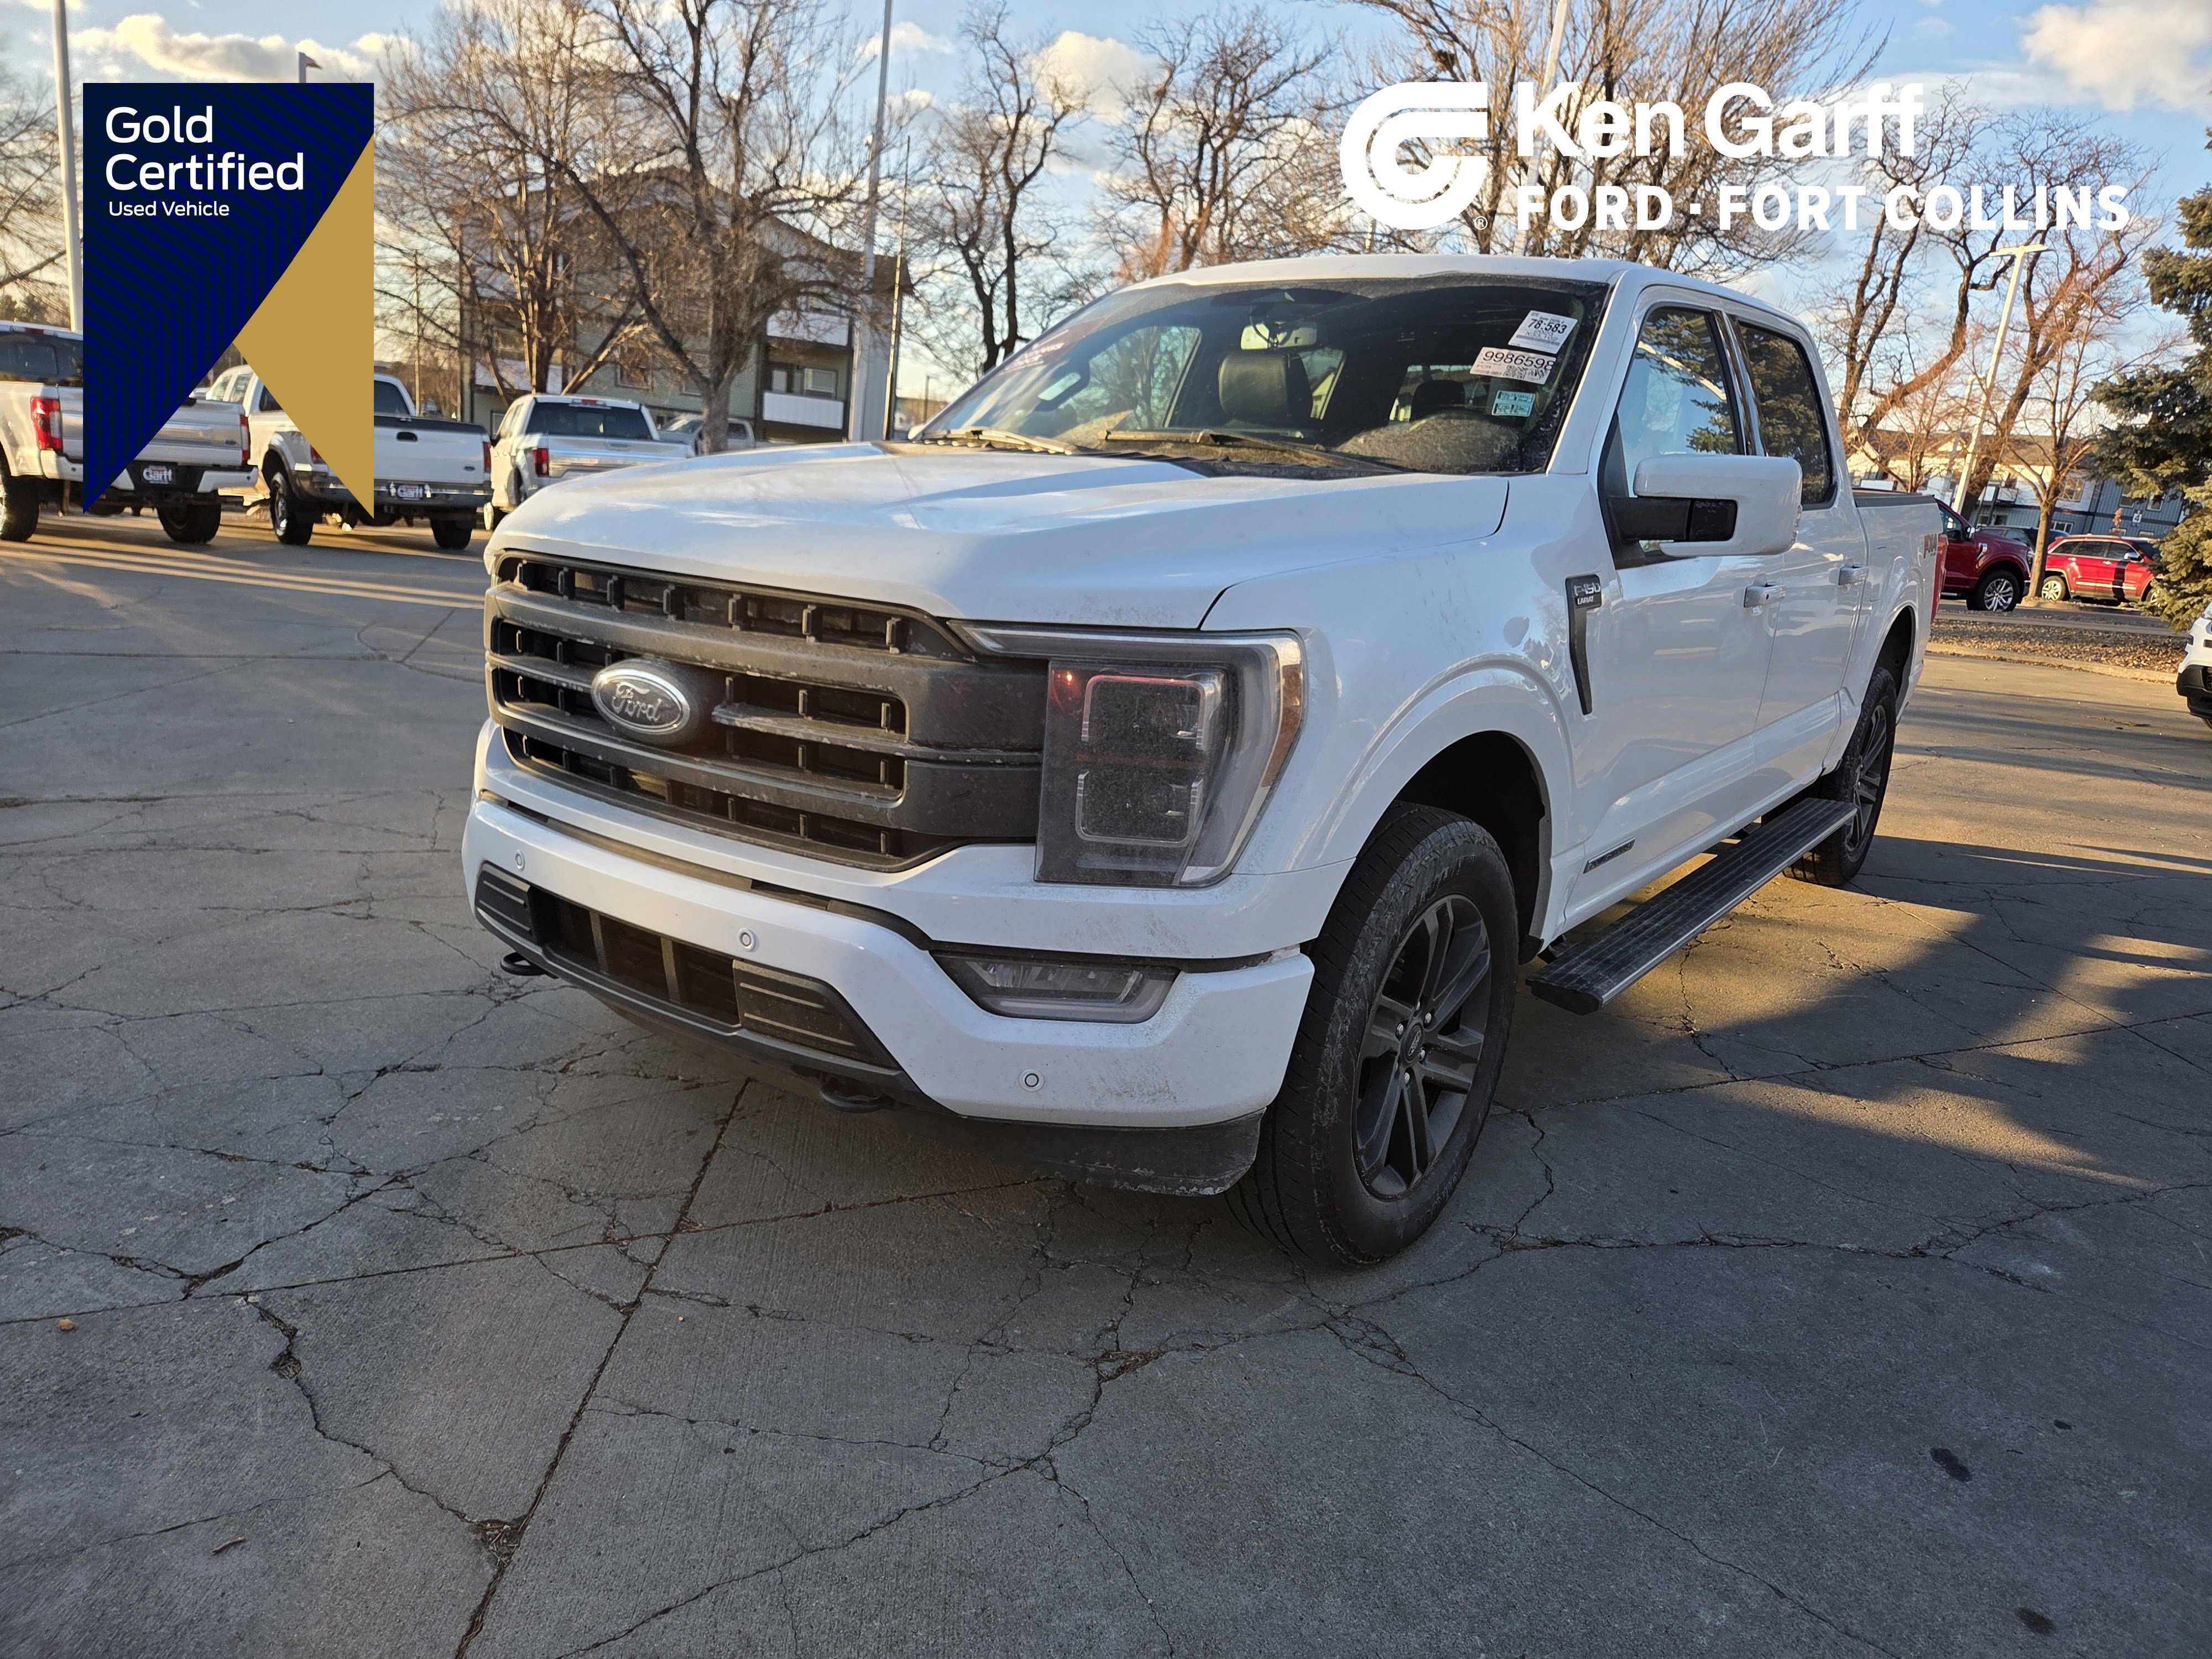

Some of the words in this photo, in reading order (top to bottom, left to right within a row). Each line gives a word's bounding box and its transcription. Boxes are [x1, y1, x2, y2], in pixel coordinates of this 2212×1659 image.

[1528, 319, 1567, 333] 78:583
[1483, 351, 1554, 371] 9986598
[612, 681, 662, 723] Ford
